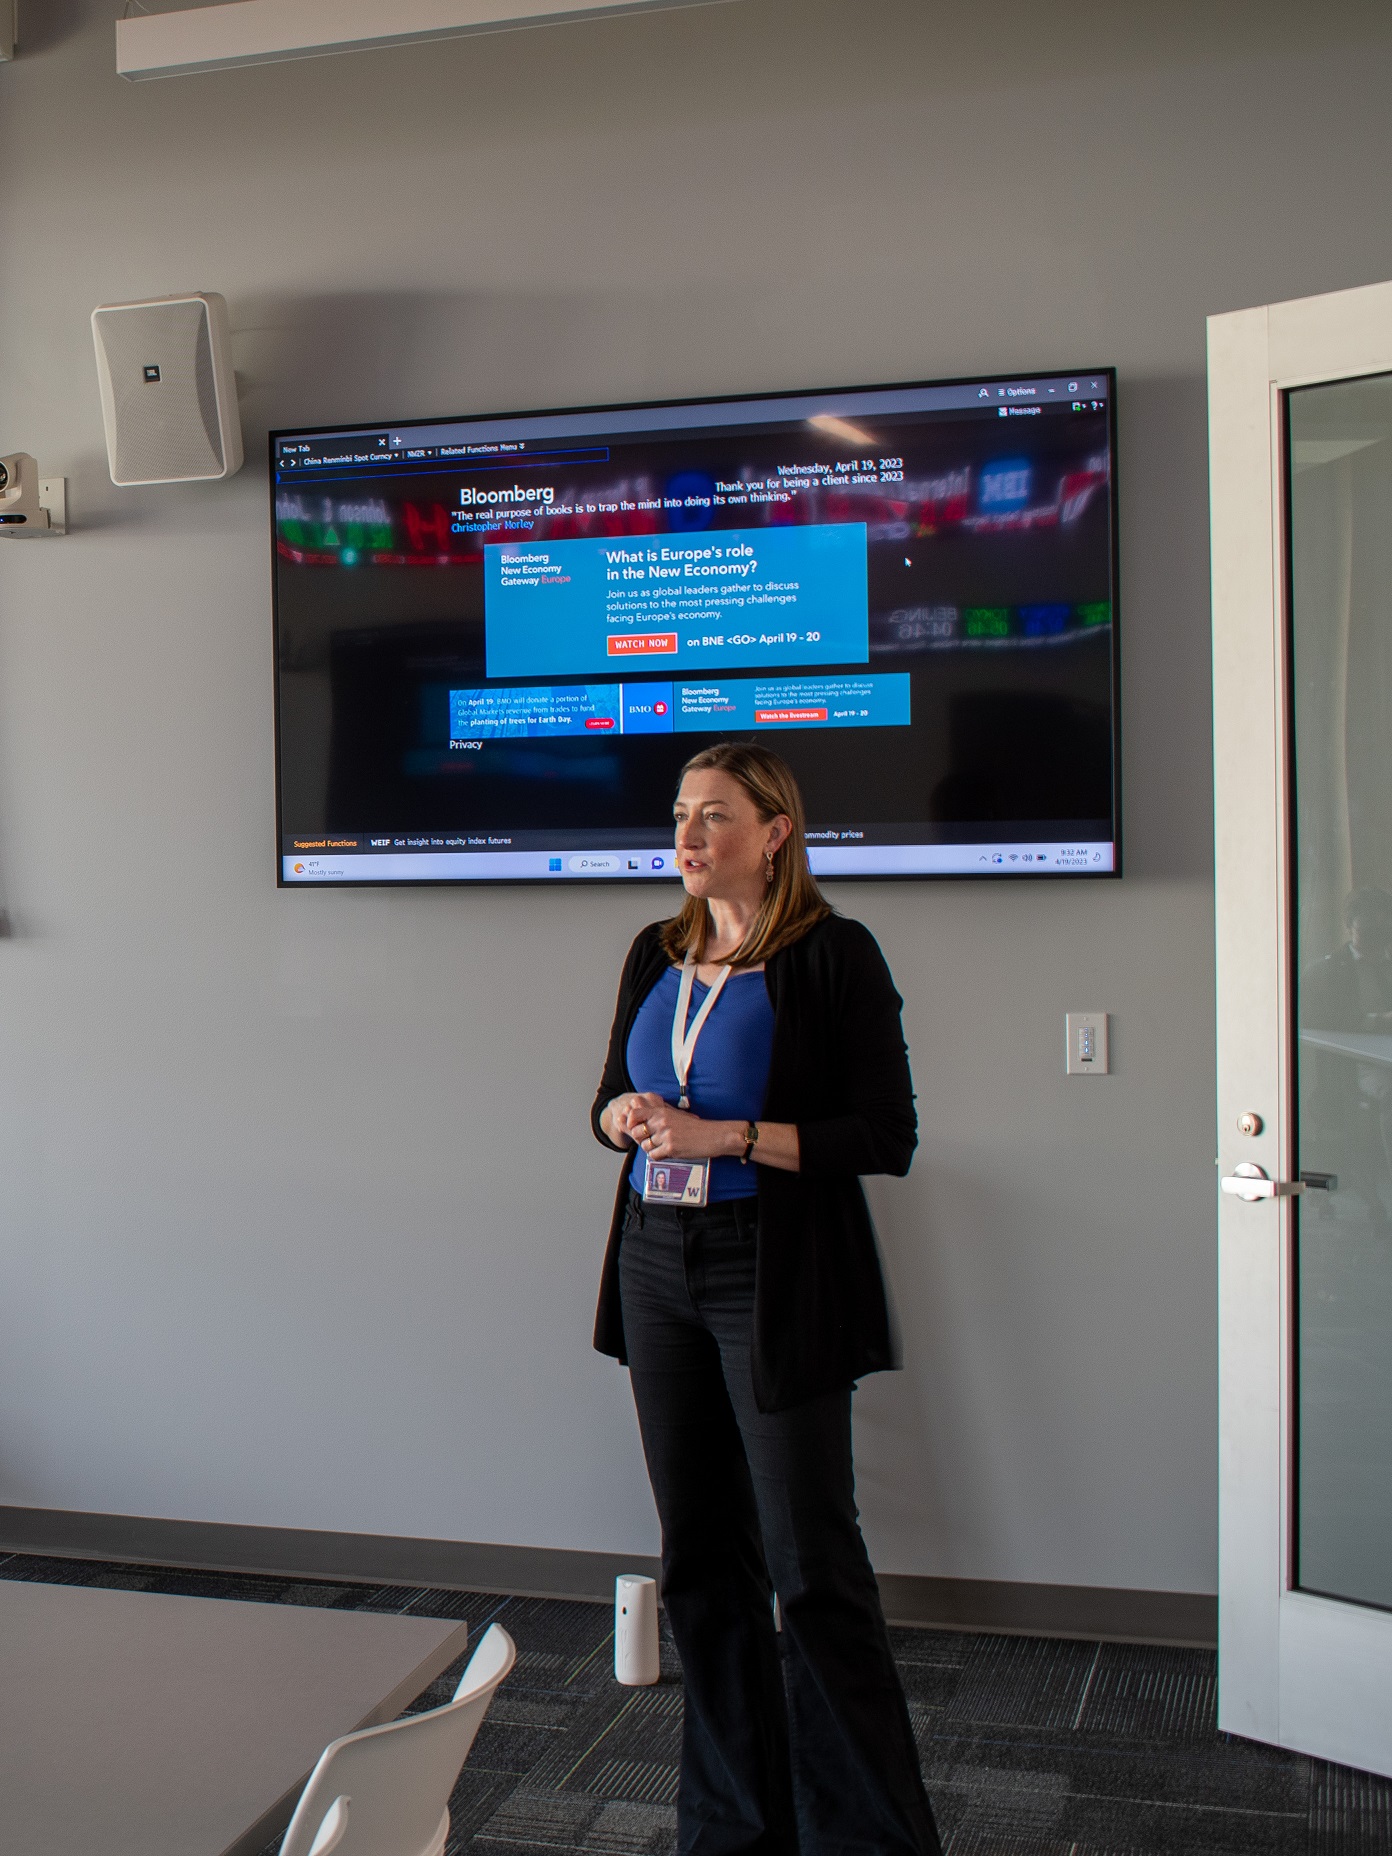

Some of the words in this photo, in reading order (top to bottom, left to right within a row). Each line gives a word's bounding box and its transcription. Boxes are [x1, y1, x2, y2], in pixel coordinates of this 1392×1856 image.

[460, 485, 554, 506] Bloomberg
[451, 509, 473, 520] "The
[475, 507, 493, 519] real
[495, 507, 531, 521] purpose
[533, 504, 543, 515] of
[545, 503, 572, 515] books
[575, 502, 583, 513] is
[586, 501, 596, 512] to
[598, 501, 618, 513] trap
[620, 499, 635, 510] the
[637, 497, 661, 509] mind
[663, 496, 682, 507] into
[684, 495, 710, 508] doing
[712, 493, 725, 504] its
[727, 494, 747, 503] own
[750, 489, 796, 503] thinking."
[451, 520, 500, 534] Christopher
[504, 518, 534, 531] Morley
[501, 553, 548, 565] Bloomberg
[606, 549, 643, 563] What
[646, 548, 657, 561] is
[660, 546, 722, 563] Europe's
[726, 544, 753, 557] role
[500, 565, 520, 575] New
[522, 564, 561, 576] Economy
[606, 567, 618, 579] in
[622, 566, 644, 579] the
[648, 565, 680, 578] New
[684, 561, 757, 578] Economy?
[500, 576, 539, 588] Gateway
[540, 574, 571, 586] Europe
[606, 588, 625, 598] Join
[627, 589, 638, 597] us
[640, 588, 650, 596] as
[652, 585, 682, 599] global
[684, 584, 718, 594] leaders
[720, 582, 750, 596] gather
[752, 581, 763, 591] to
[764, 581, 798, 590] discuss
[606, 599, 647, 610] solutions
[649, 598, 659, 608] to
[661, 598, 676, 607] the
[678, 596, 702, 607] most
[704, 595, 744, 609] pressing
[746, 593, 796, 605] challenges
[606, 611, 633, 624] facing
[636, 610, 675, 623] Europe's
[678, 610, 722, 620] economy.
[615, 638, 644, 648] WATCH
[648, 638, 667, 647] NOW
[686, 637, 700, 646] on
[702, 634, 723, 645] BNE
[726, 633, 756, 644] <GO>
[759, 632, 784, 646] April
[786, 631, 796, 642] 19
[806, 630, 820, 641] 20
[629, 705, 651, 713] BMO
[449, 739, 482, 751] Privacy
[294, 840, 326, 850] Suggested
[327, 839, 356, 847] Functions
[370, 838, 390, 846] WEIF
[394, 838, 405, 846] Get
[406, 837, 429, 848] insight
[430, 837, 443, 845] into
[445, 837, 466, 847] equity
[467, 836, 486, 845] index
[487, 836, 511, 844] futures
[687, 1187, 699, 1197] W
